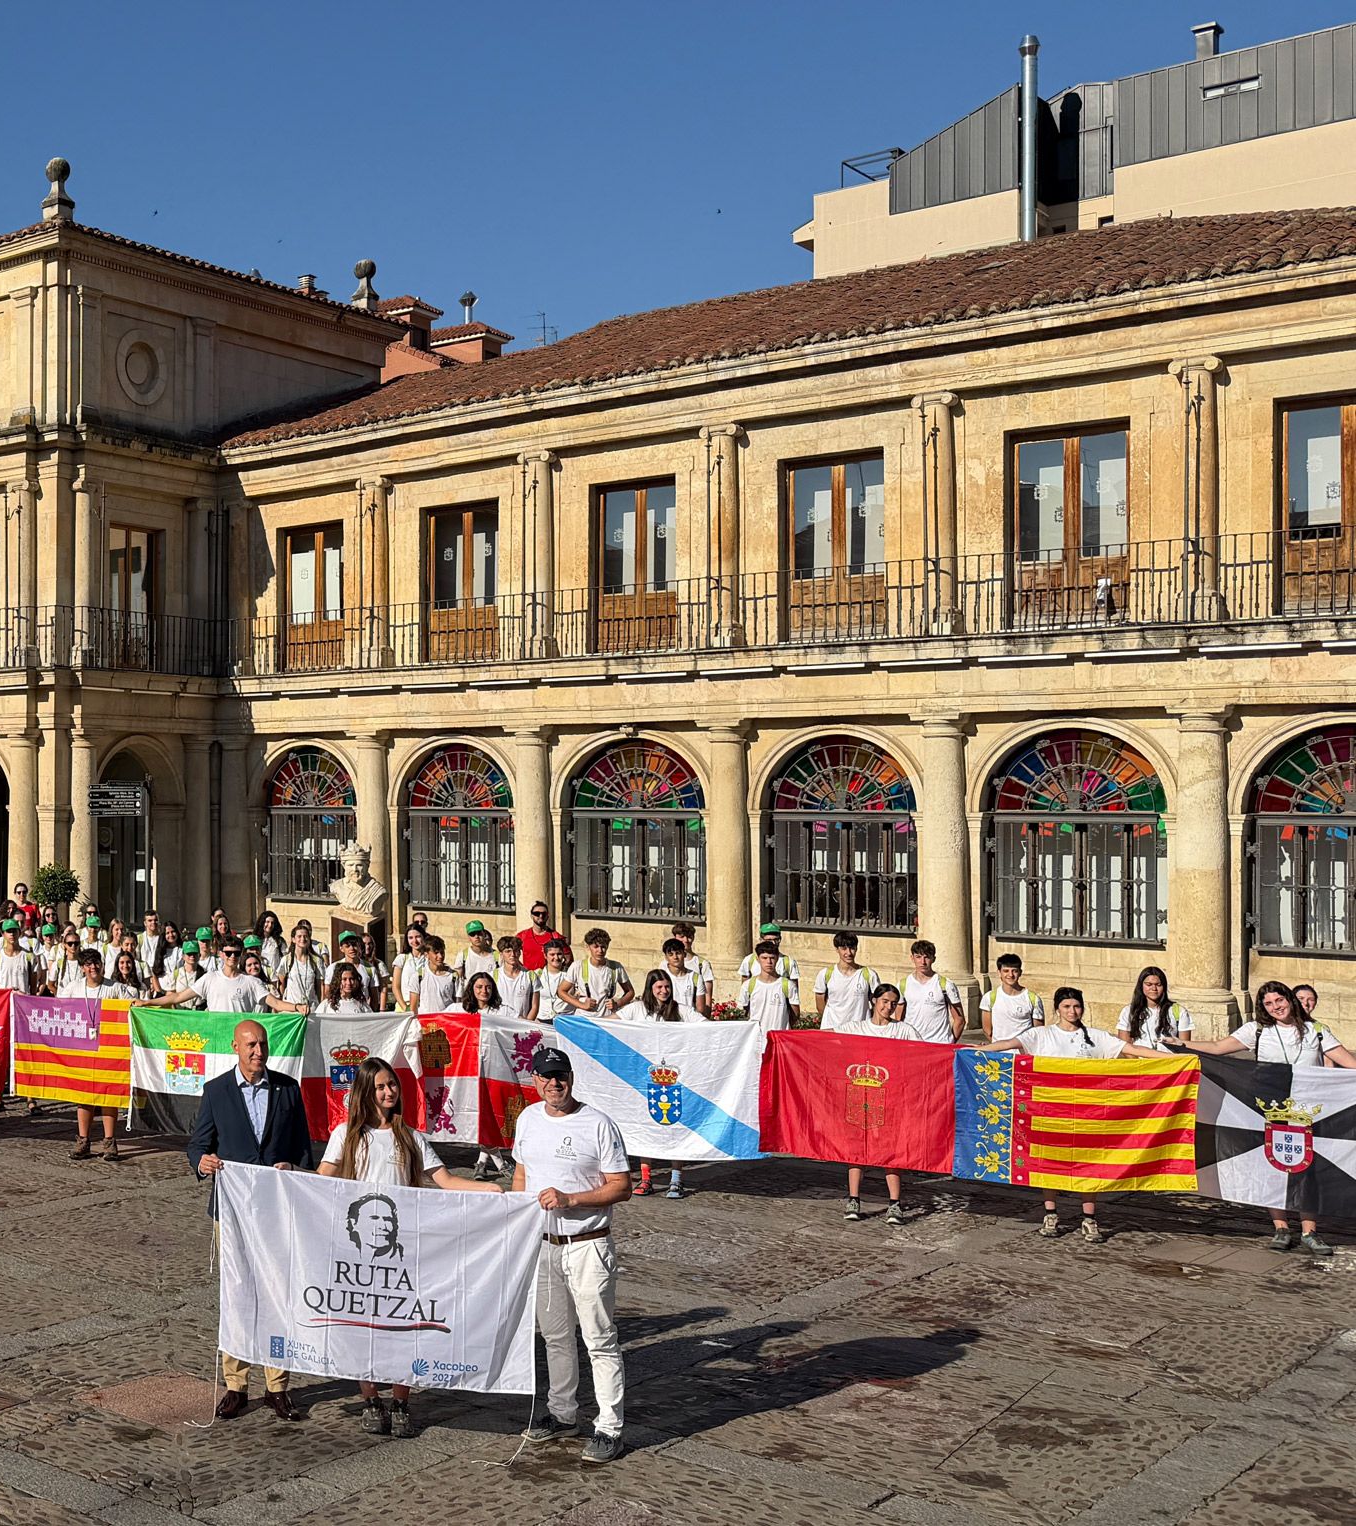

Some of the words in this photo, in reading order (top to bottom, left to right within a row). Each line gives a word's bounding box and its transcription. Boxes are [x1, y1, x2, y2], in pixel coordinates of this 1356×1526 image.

[334, 1260, 415, 1291] RUTA
[303, 1286, 447, 1323] QUETZAL
[287, 1340, 317, 1354] XUNTA
[287, 1349, 299, 1359] DE
[301, 1352, 336, 1367] GALICIA
[432, 1360, 478, 1373] Xacobeo
[432, 1373, 454, 1383] 2027
